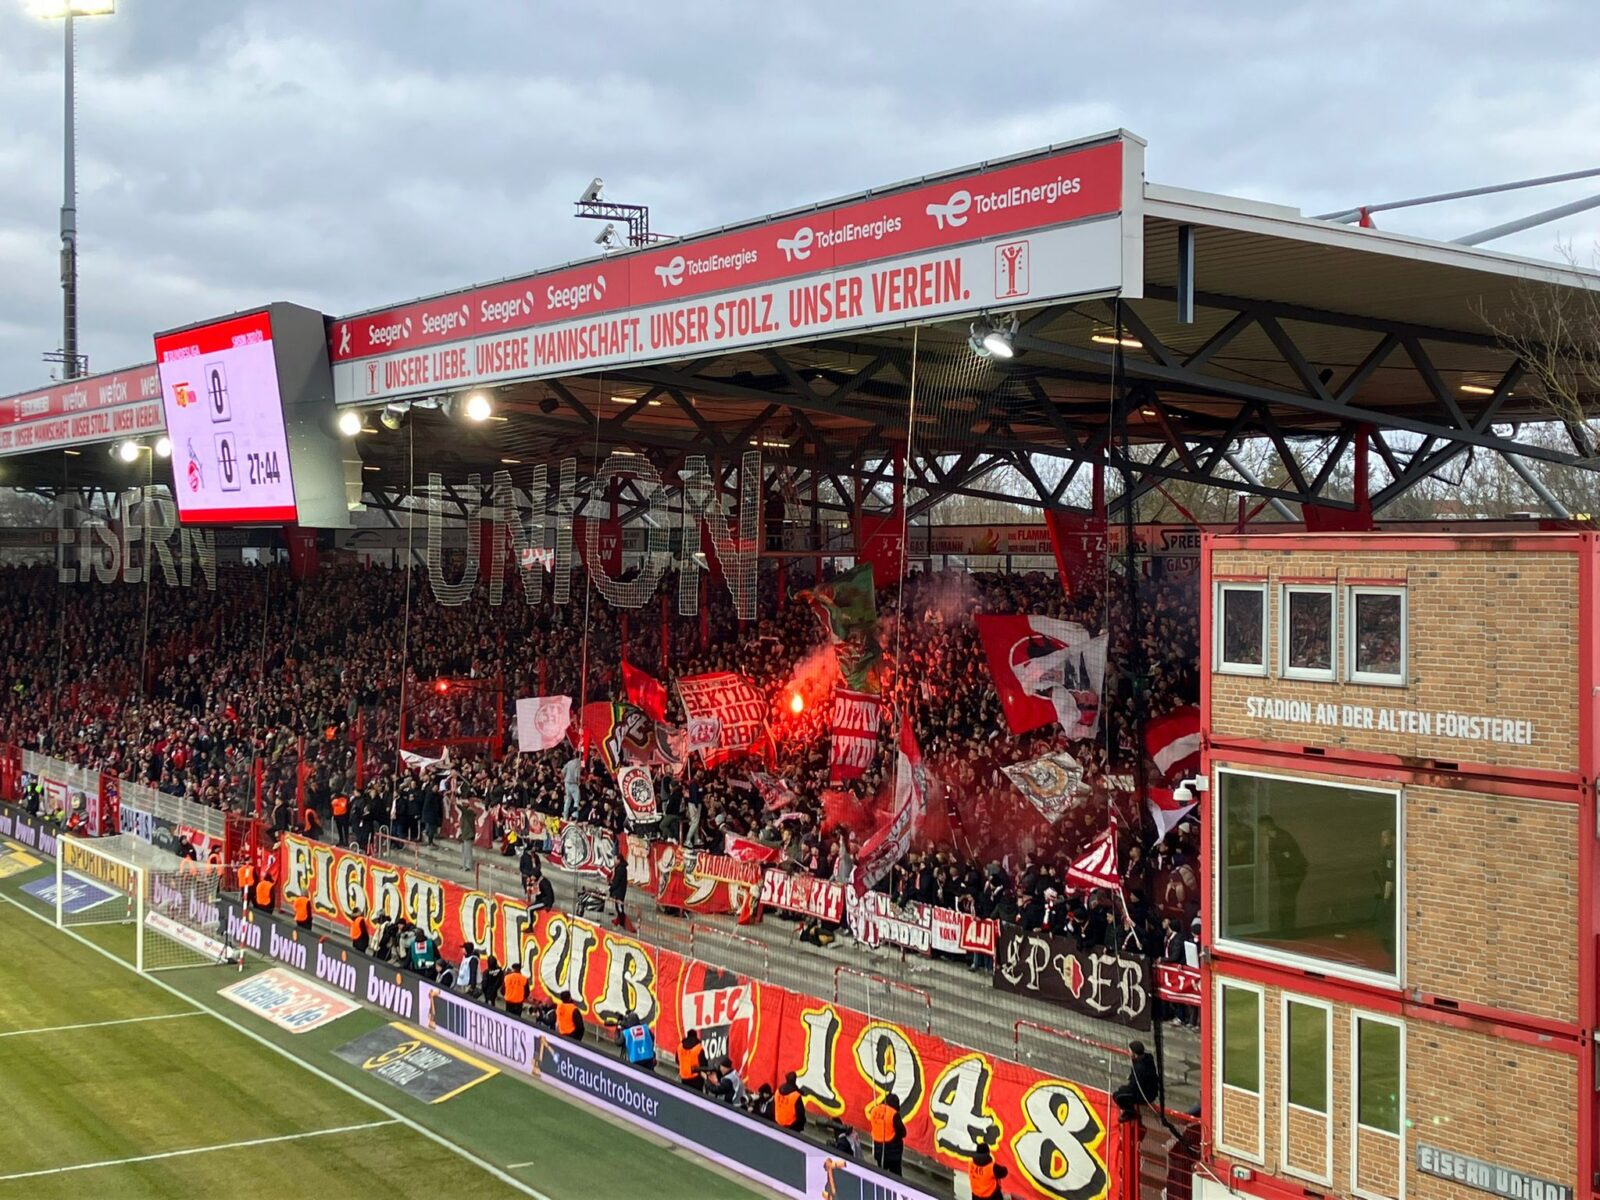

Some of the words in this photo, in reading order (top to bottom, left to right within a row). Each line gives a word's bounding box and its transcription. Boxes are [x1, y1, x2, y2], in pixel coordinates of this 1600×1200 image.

[974, 175, 1081, 214] TotalEnergies
[815, 215, 902, 250] TotalEnergies
[686, 247, 758, 276] TotalEnergies
[481, 297, 522, 324] Seeger
[547, 283, 592, 310] Seeger
[368, 323, 402, 346] Seeger
[384, 355, 429, 390] UNSERE
[433, 348, 471, 382] LIEBE.
[476, 337, 528, 375] UNSERE
[534, 317, 644, 367] MANNSCHAFT.
[650, 305, 709, 350] UNSER
[714, 294, 780, 340] STOLZ.
[789, 276, 863, 327] UNSER
[871, 258, 970, 314] VEREIN.
[422, 311, 458, 336] Seeger
[99, 376, 127, 405] wefox
[247, 451, 281, 484] 27:44
[427, 451, 762, 620] UNION
[1246, 697, 1312, 724] STADION
[1316, 703, 1338, 726] AN
[1342, 705, 1374, 730] DER
[1378, 709, 1431, 735] ALTEN
[1435, 710, 1532, 745] FÖRSTEREI
[228, 905, 261, 950] bwin
[269, 923, 307, 971] bwin
[316, 942, 357, 993] bwin
[460, 890, 660, 1025] CLUB
[367, 963, 413, 1018] bwin
[694, 988, 743, 1026] 1.FC
[469, 1009, 527, 1066] HERRLES
[556, 1058, 659, 1117] ebrauchtroboter
[797, 1004, 1114, 1200] 1948
